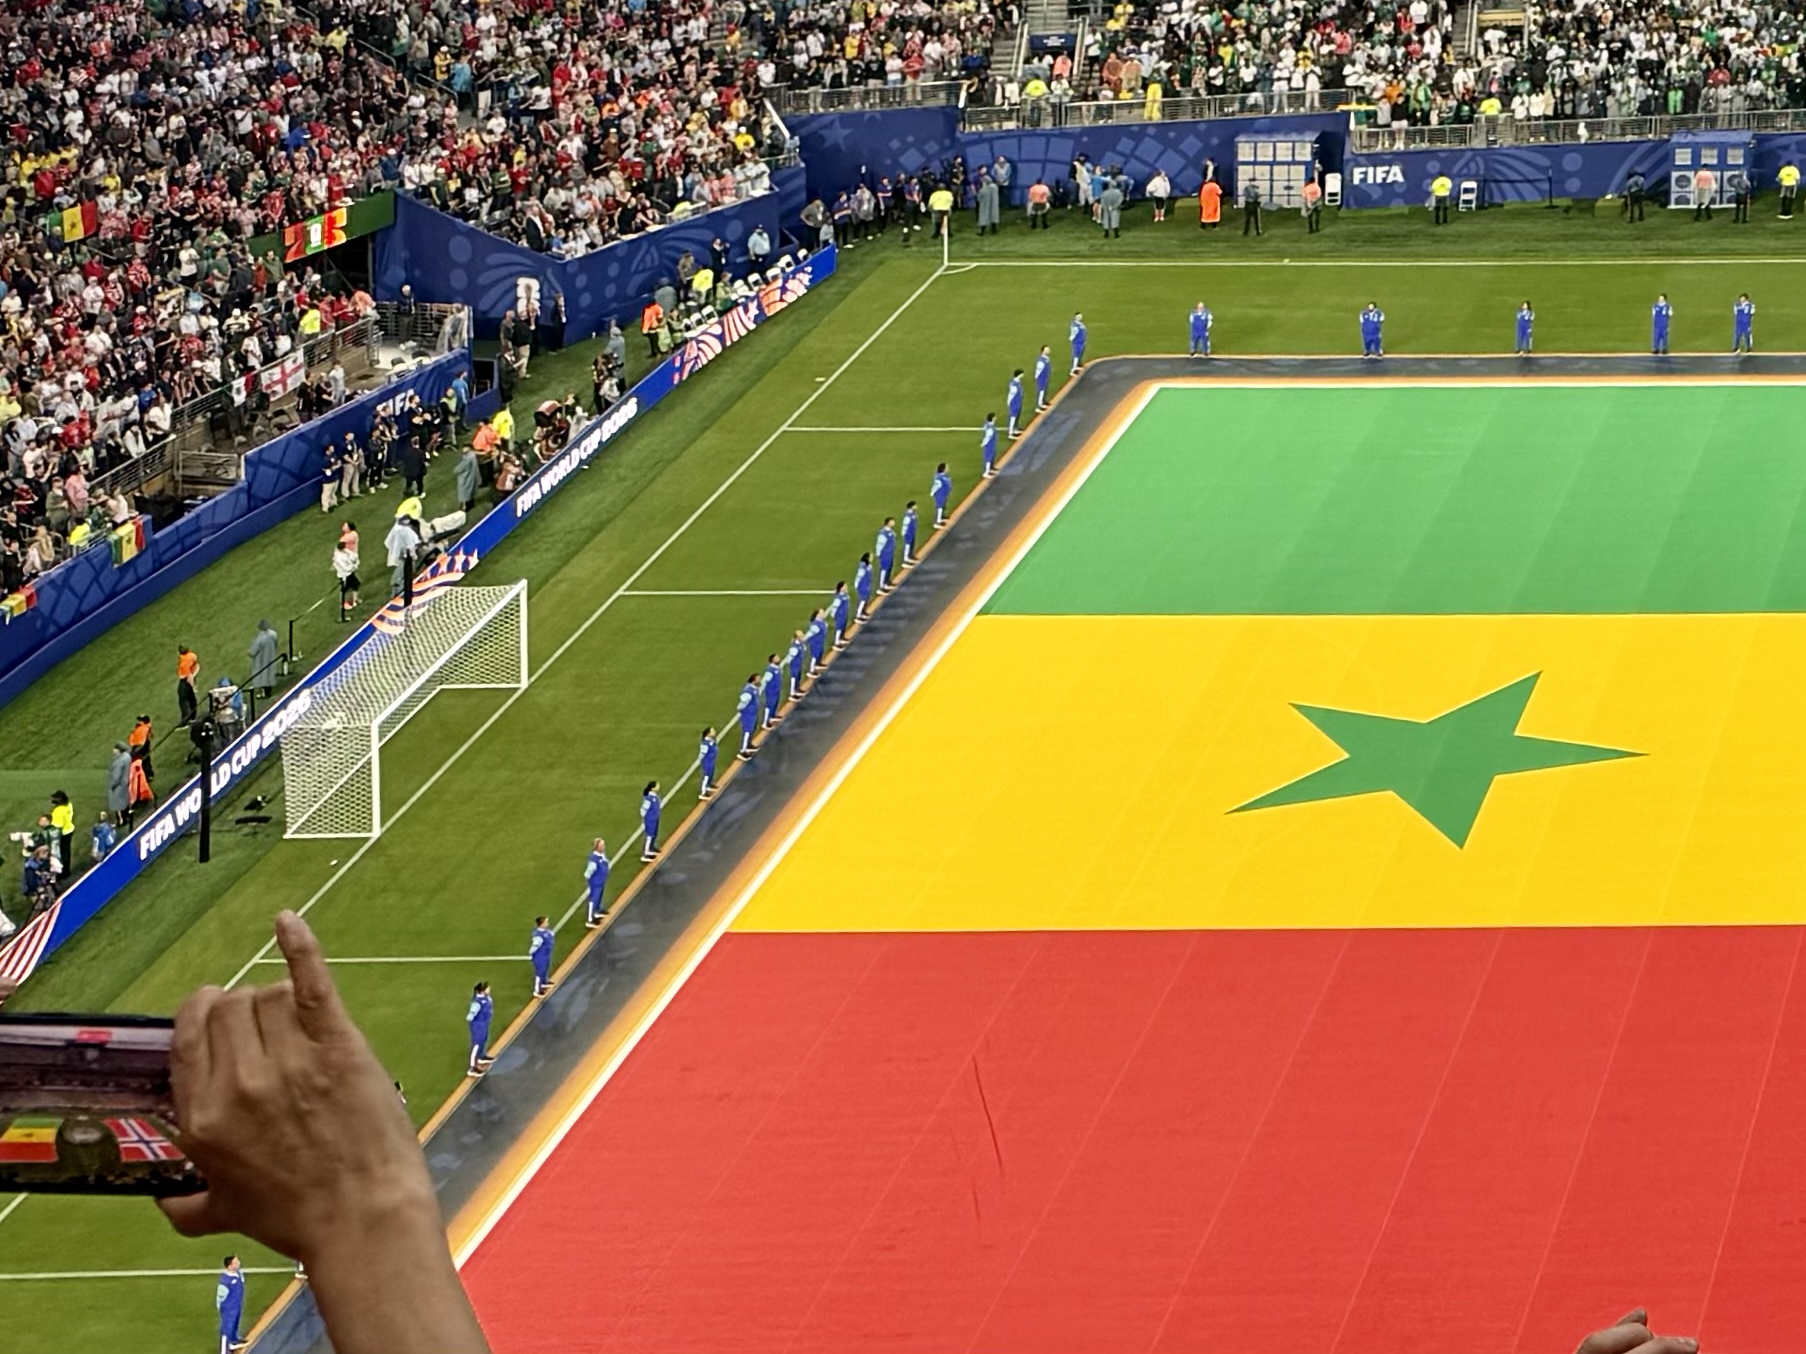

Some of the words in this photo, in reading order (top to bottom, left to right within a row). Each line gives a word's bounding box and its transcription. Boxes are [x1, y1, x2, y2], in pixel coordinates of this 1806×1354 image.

[1353, 165, 1405, 185] FIFA
[516, 481, 542, 517] FIFA
[540, 448, 580, 494] WORLD
[580, 427, 602, 459] CUP
[601, 397, 638, 442] 2026
[140, 813, 176, 860] FIFA
[175, 762, 231, 826] WOLD
[231, 734, 261, 775] CUP
[261, 688, 311, 749] 2026
